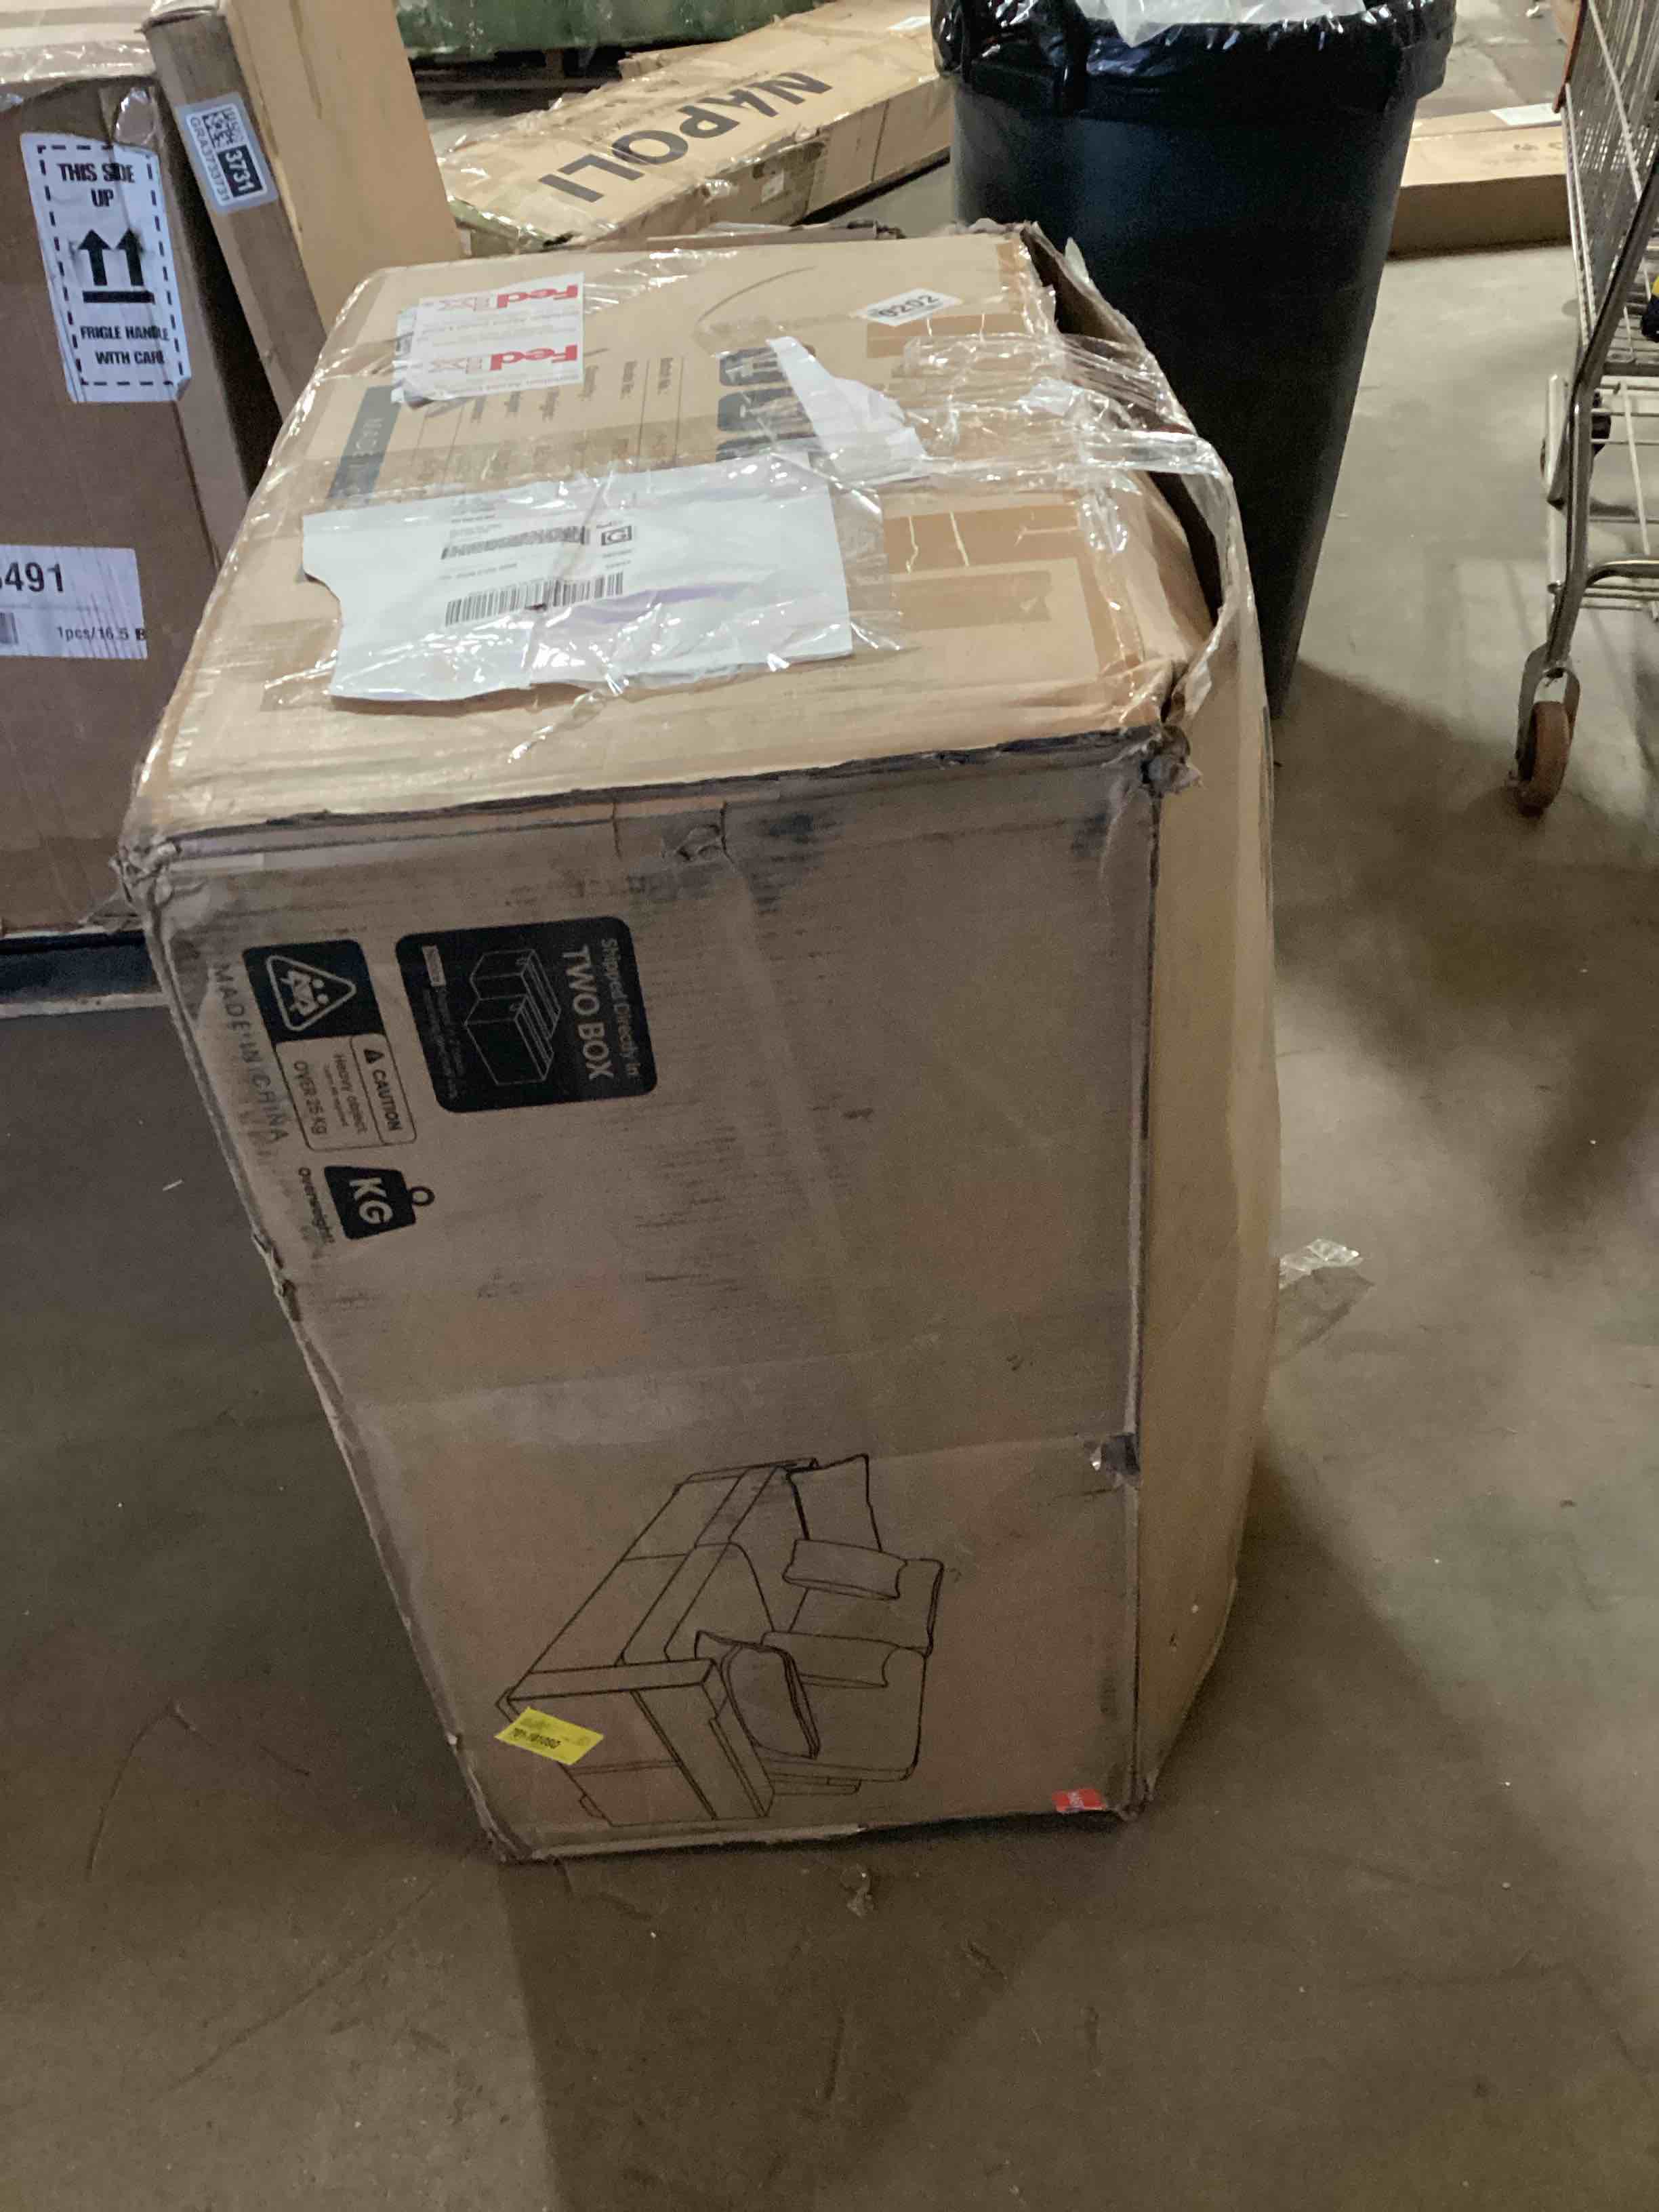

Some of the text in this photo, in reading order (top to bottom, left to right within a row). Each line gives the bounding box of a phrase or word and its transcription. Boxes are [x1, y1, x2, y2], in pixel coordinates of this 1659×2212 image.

[539, 71, 832, 203] NAPOLI
[57, 163, 136, 183] THIS SIDE
[225, 149, 255, 192] 3731
[90, 188, 115, 207] UP
[124, 325, 169, 341] HANDLE
[94, 350, 131, 365] WITH
[0, 561, 64, 593] 491
[562, 944, 615, 1081] TWO BOX
[373, 1069, 403, 1131] CAUTION
[348, 1177, 394, 1225] KG
